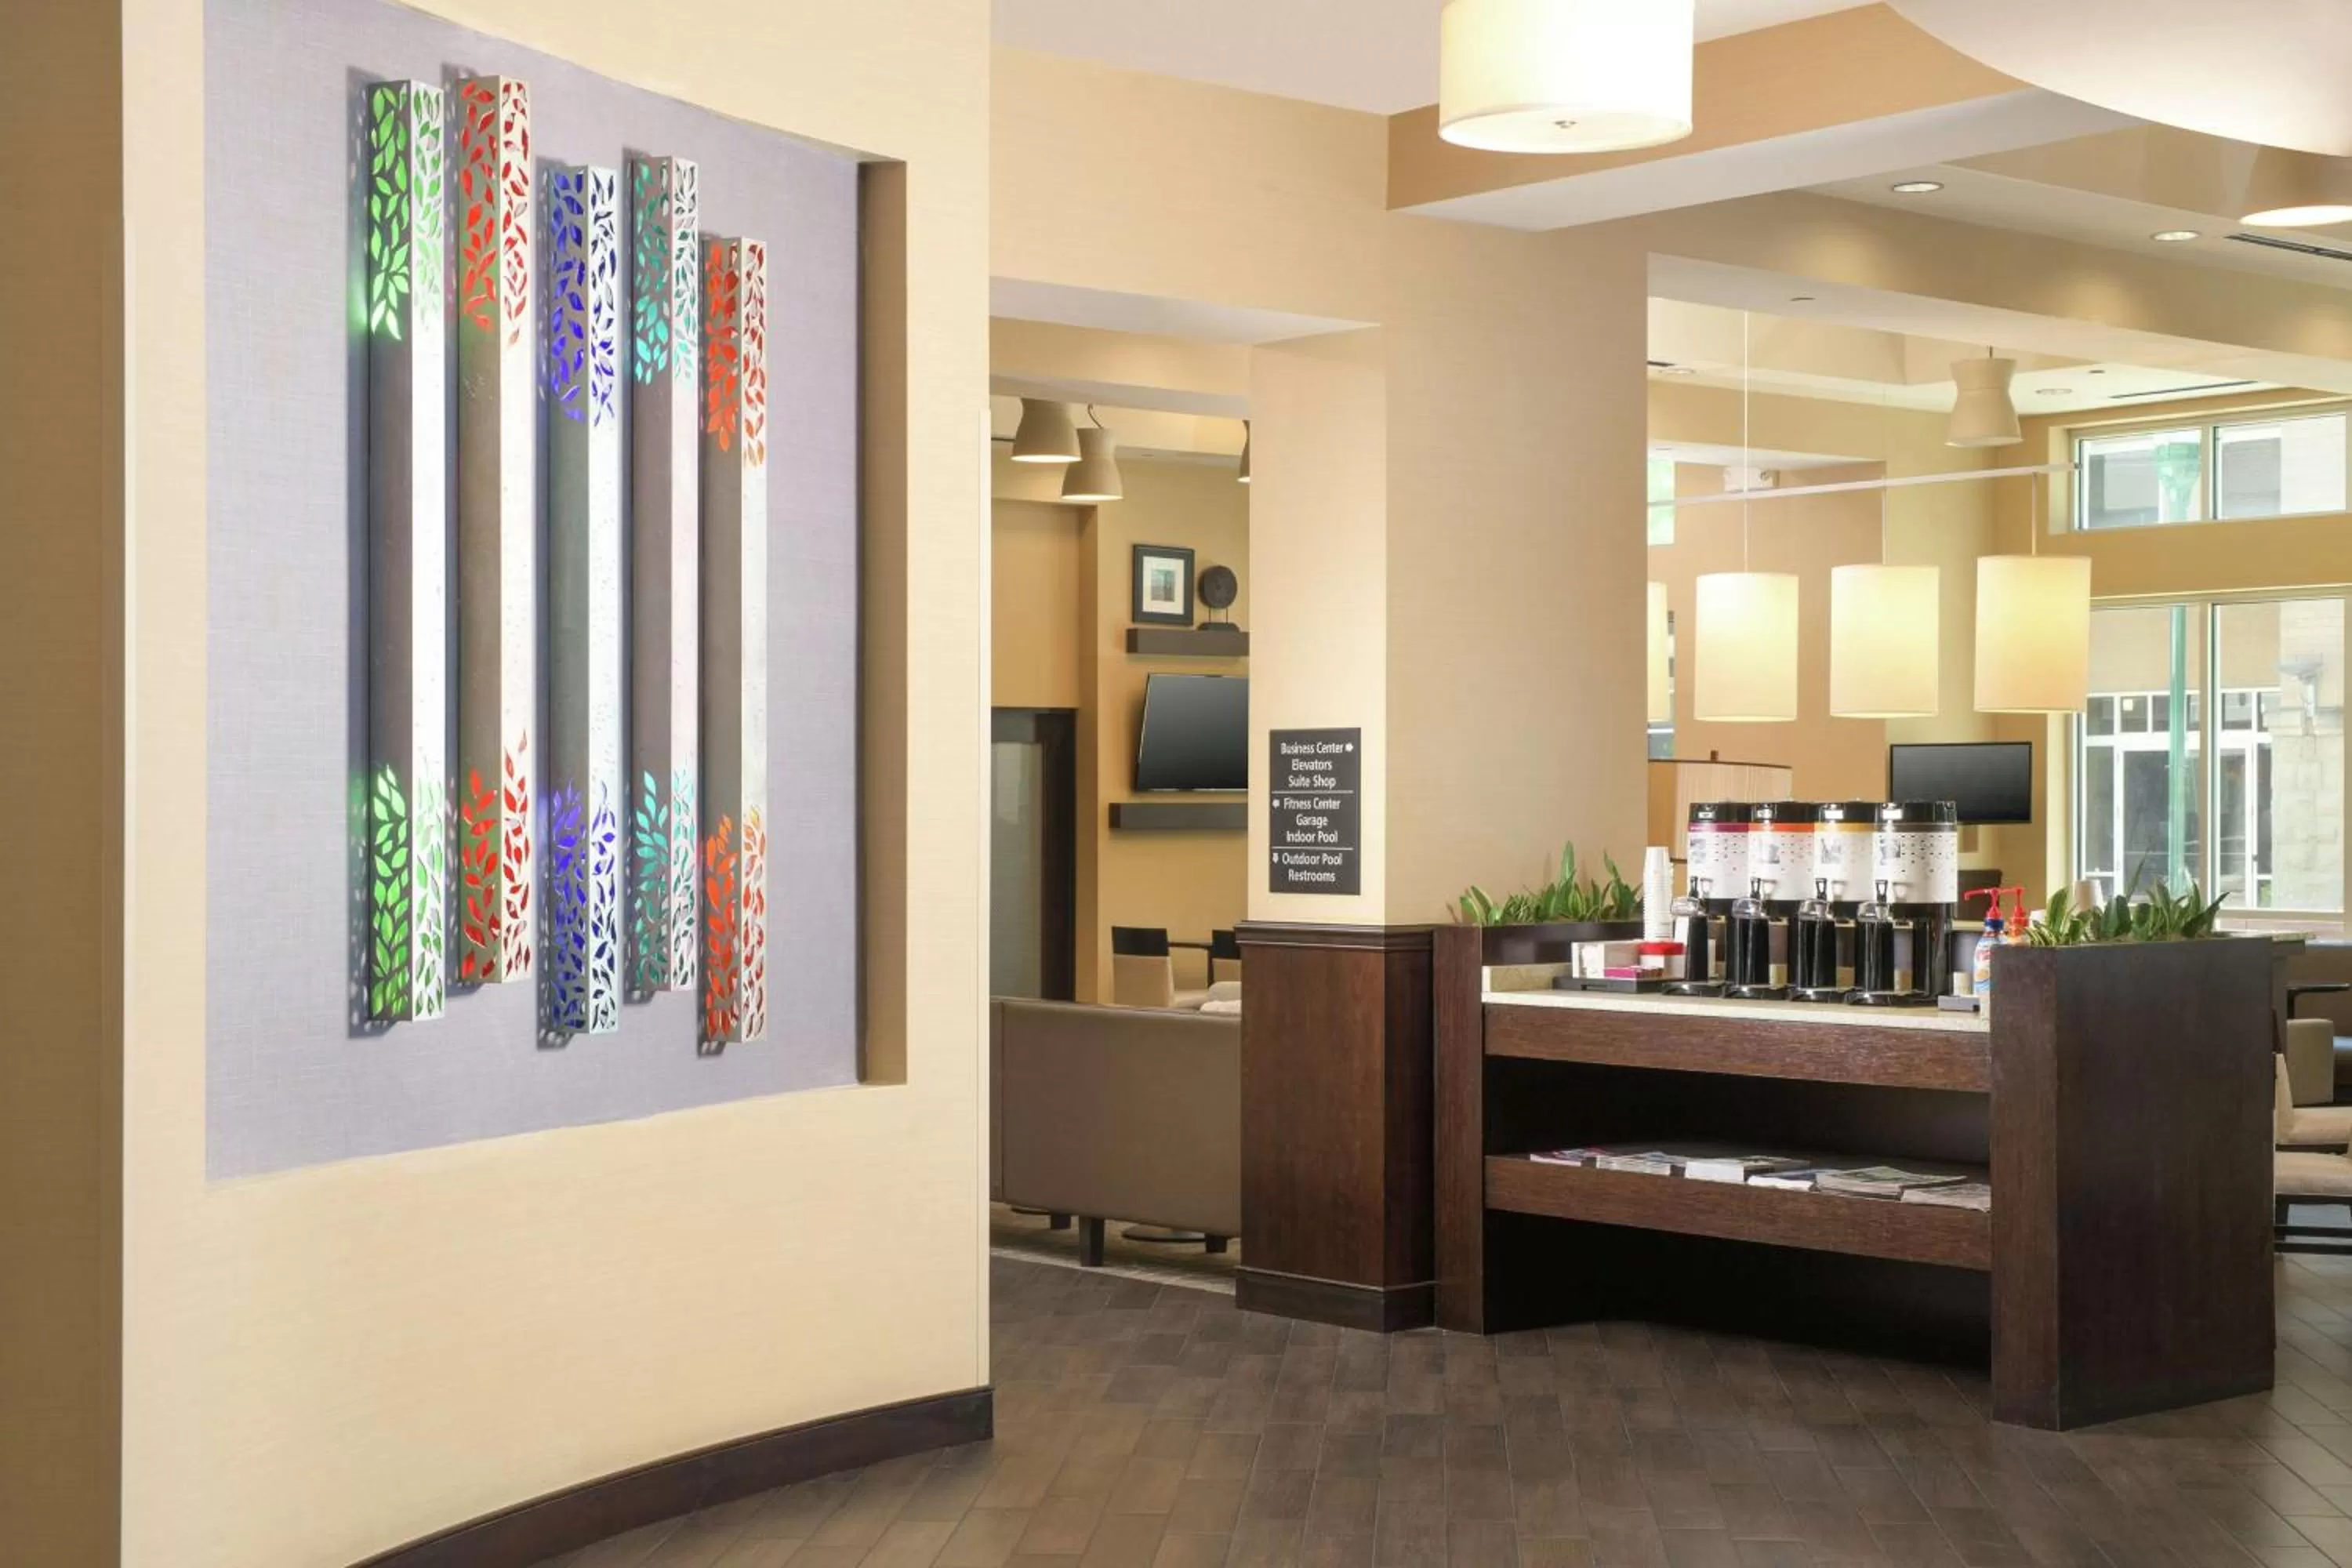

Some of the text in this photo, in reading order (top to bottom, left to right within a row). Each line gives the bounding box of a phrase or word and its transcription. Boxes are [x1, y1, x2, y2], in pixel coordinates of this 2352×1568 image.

[1280, 742, 1344, 755] Business Center
[1291, 759, 1332, 771] Elevators
[1288, 775, 1336, 789] Suite Shop
[1283, 797, 1341, 810] Fitness Center
[1296, 814, 1328, 829] Garage
[1287, 831, 1338, 843] Indoor Pool
[1282, 853, 1343, 866] Outdoor Pool
[1288, 869, 1336, 882] Restrooms
